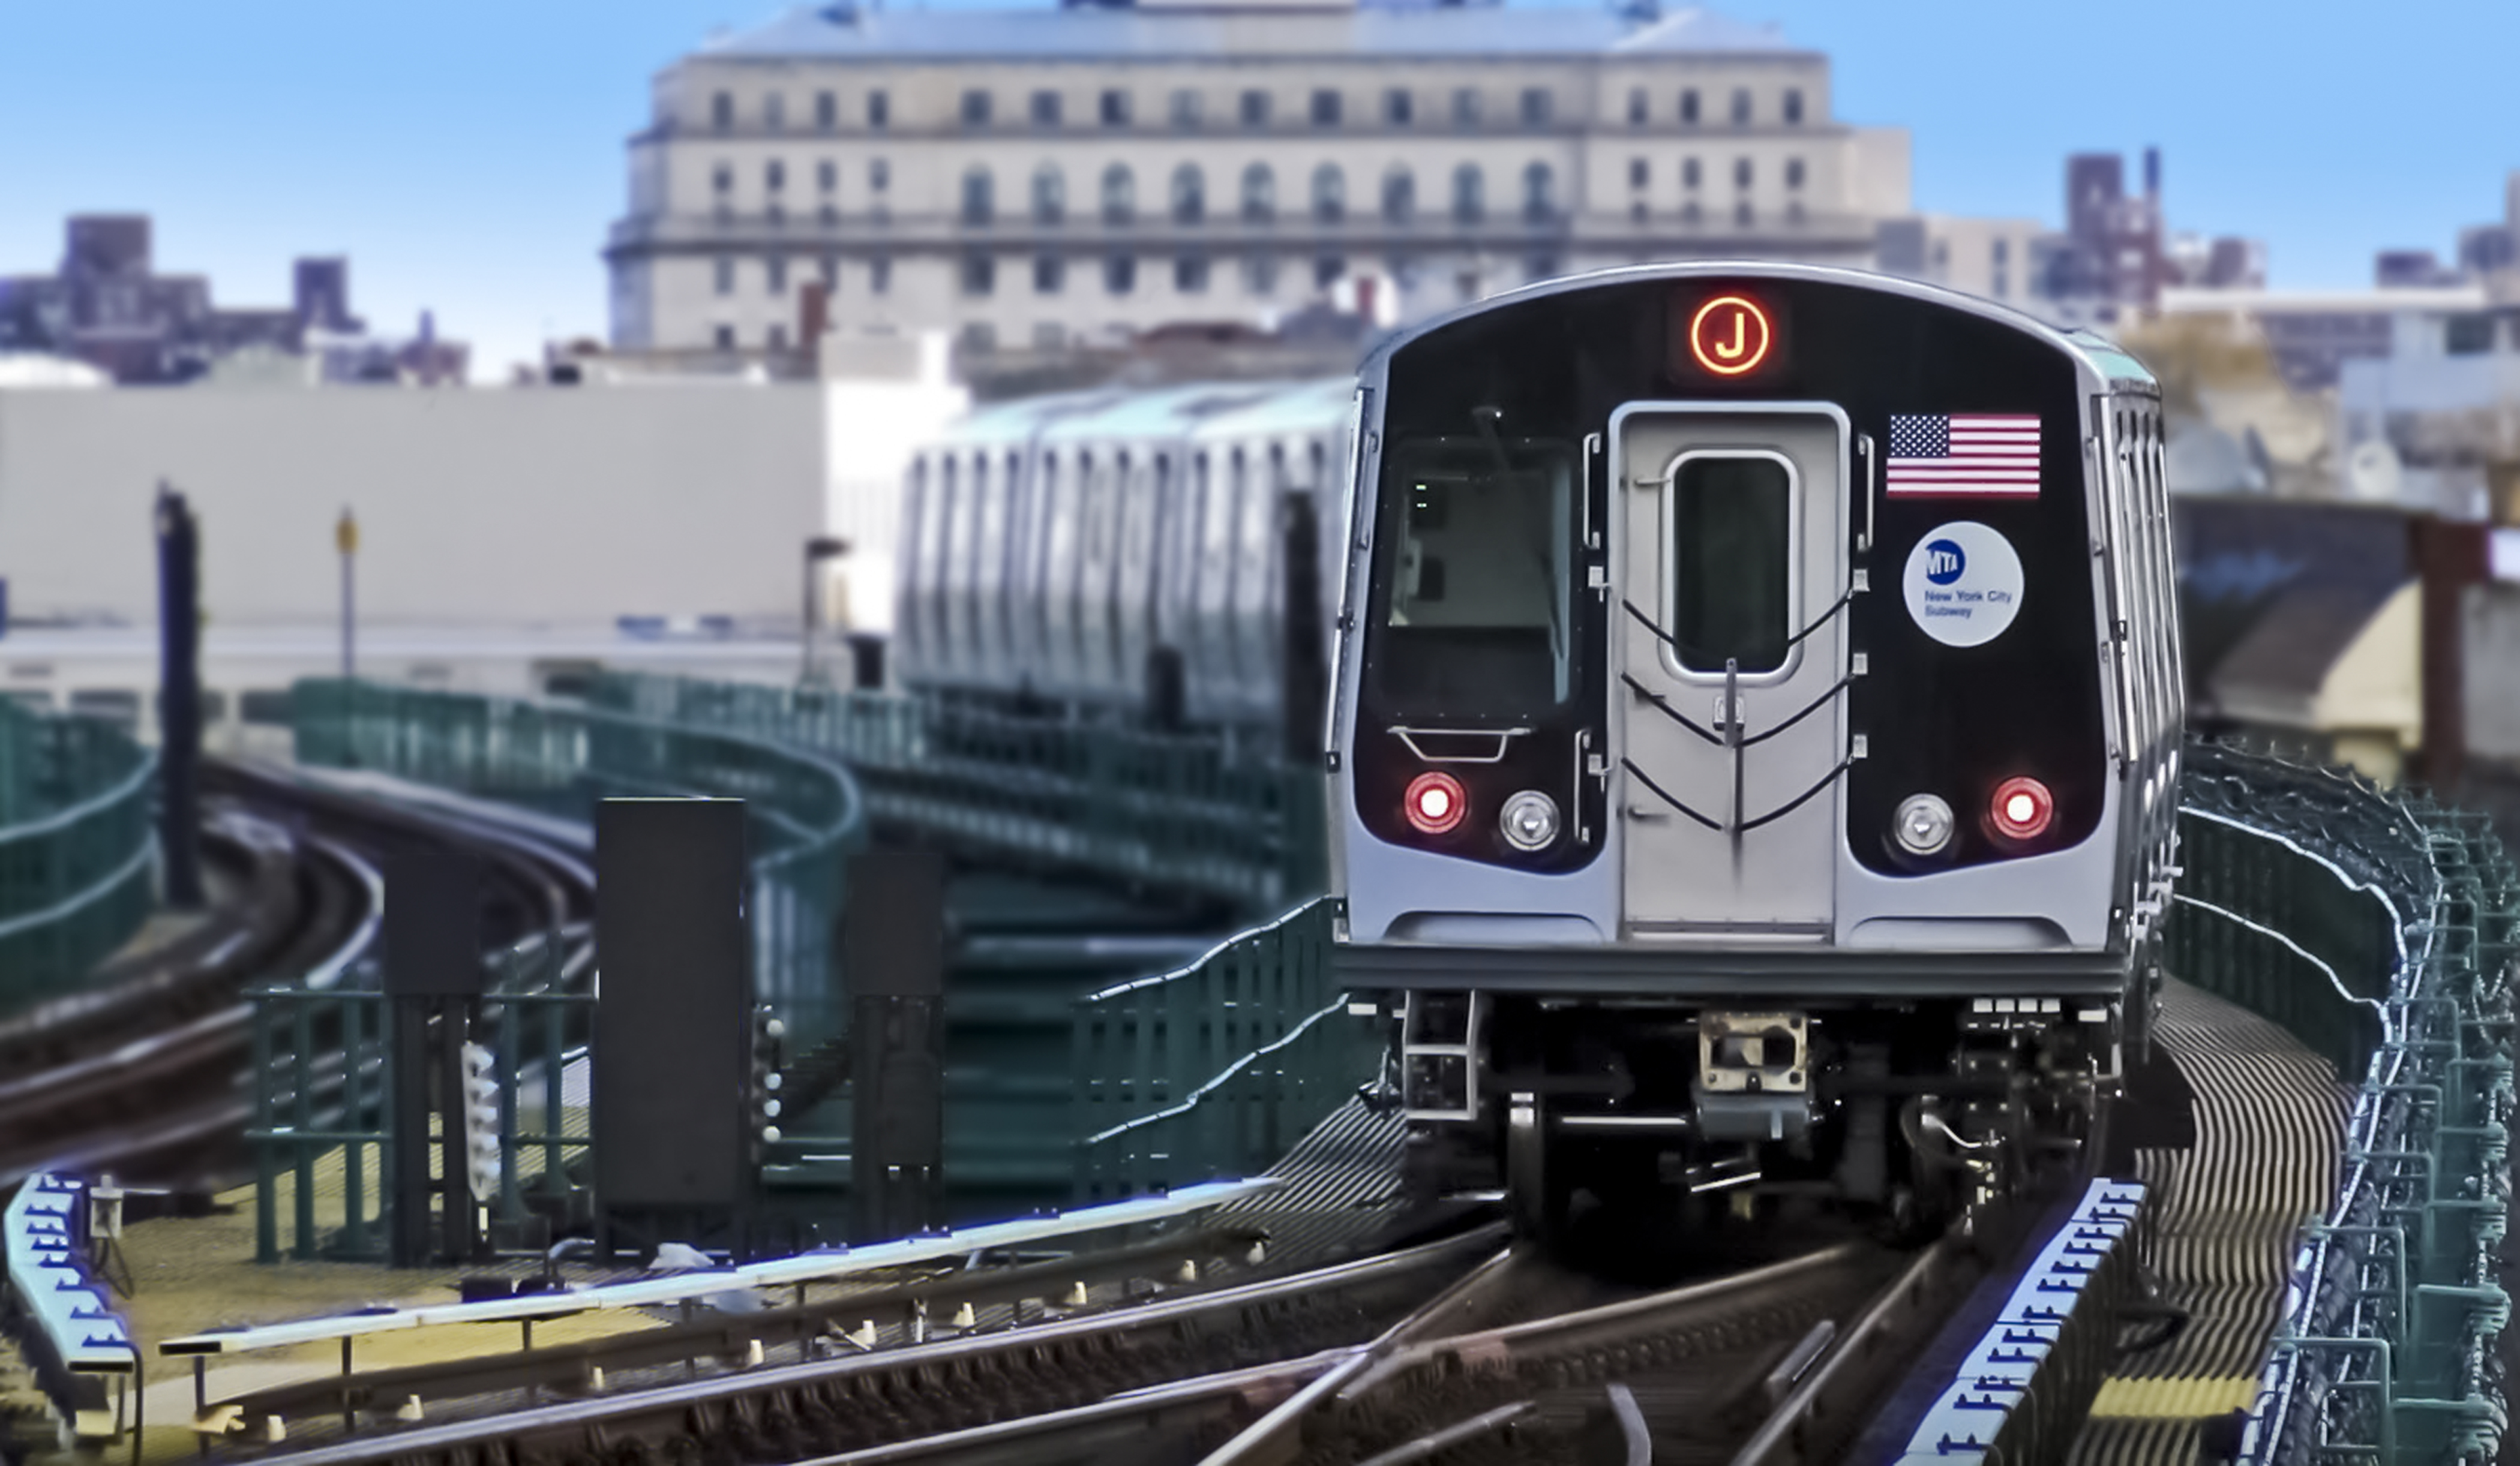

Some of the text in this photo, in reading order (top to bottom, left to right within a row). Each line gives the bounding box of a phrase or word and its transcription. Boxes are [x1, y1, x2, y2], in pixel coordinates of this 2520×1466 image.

[1715, 312, 1745, 359] J
[1926, 549, 1959, 575] MTA
[1924, 590, 2012, 604] New York City
[1924, 605, 1973, 619] Subway
